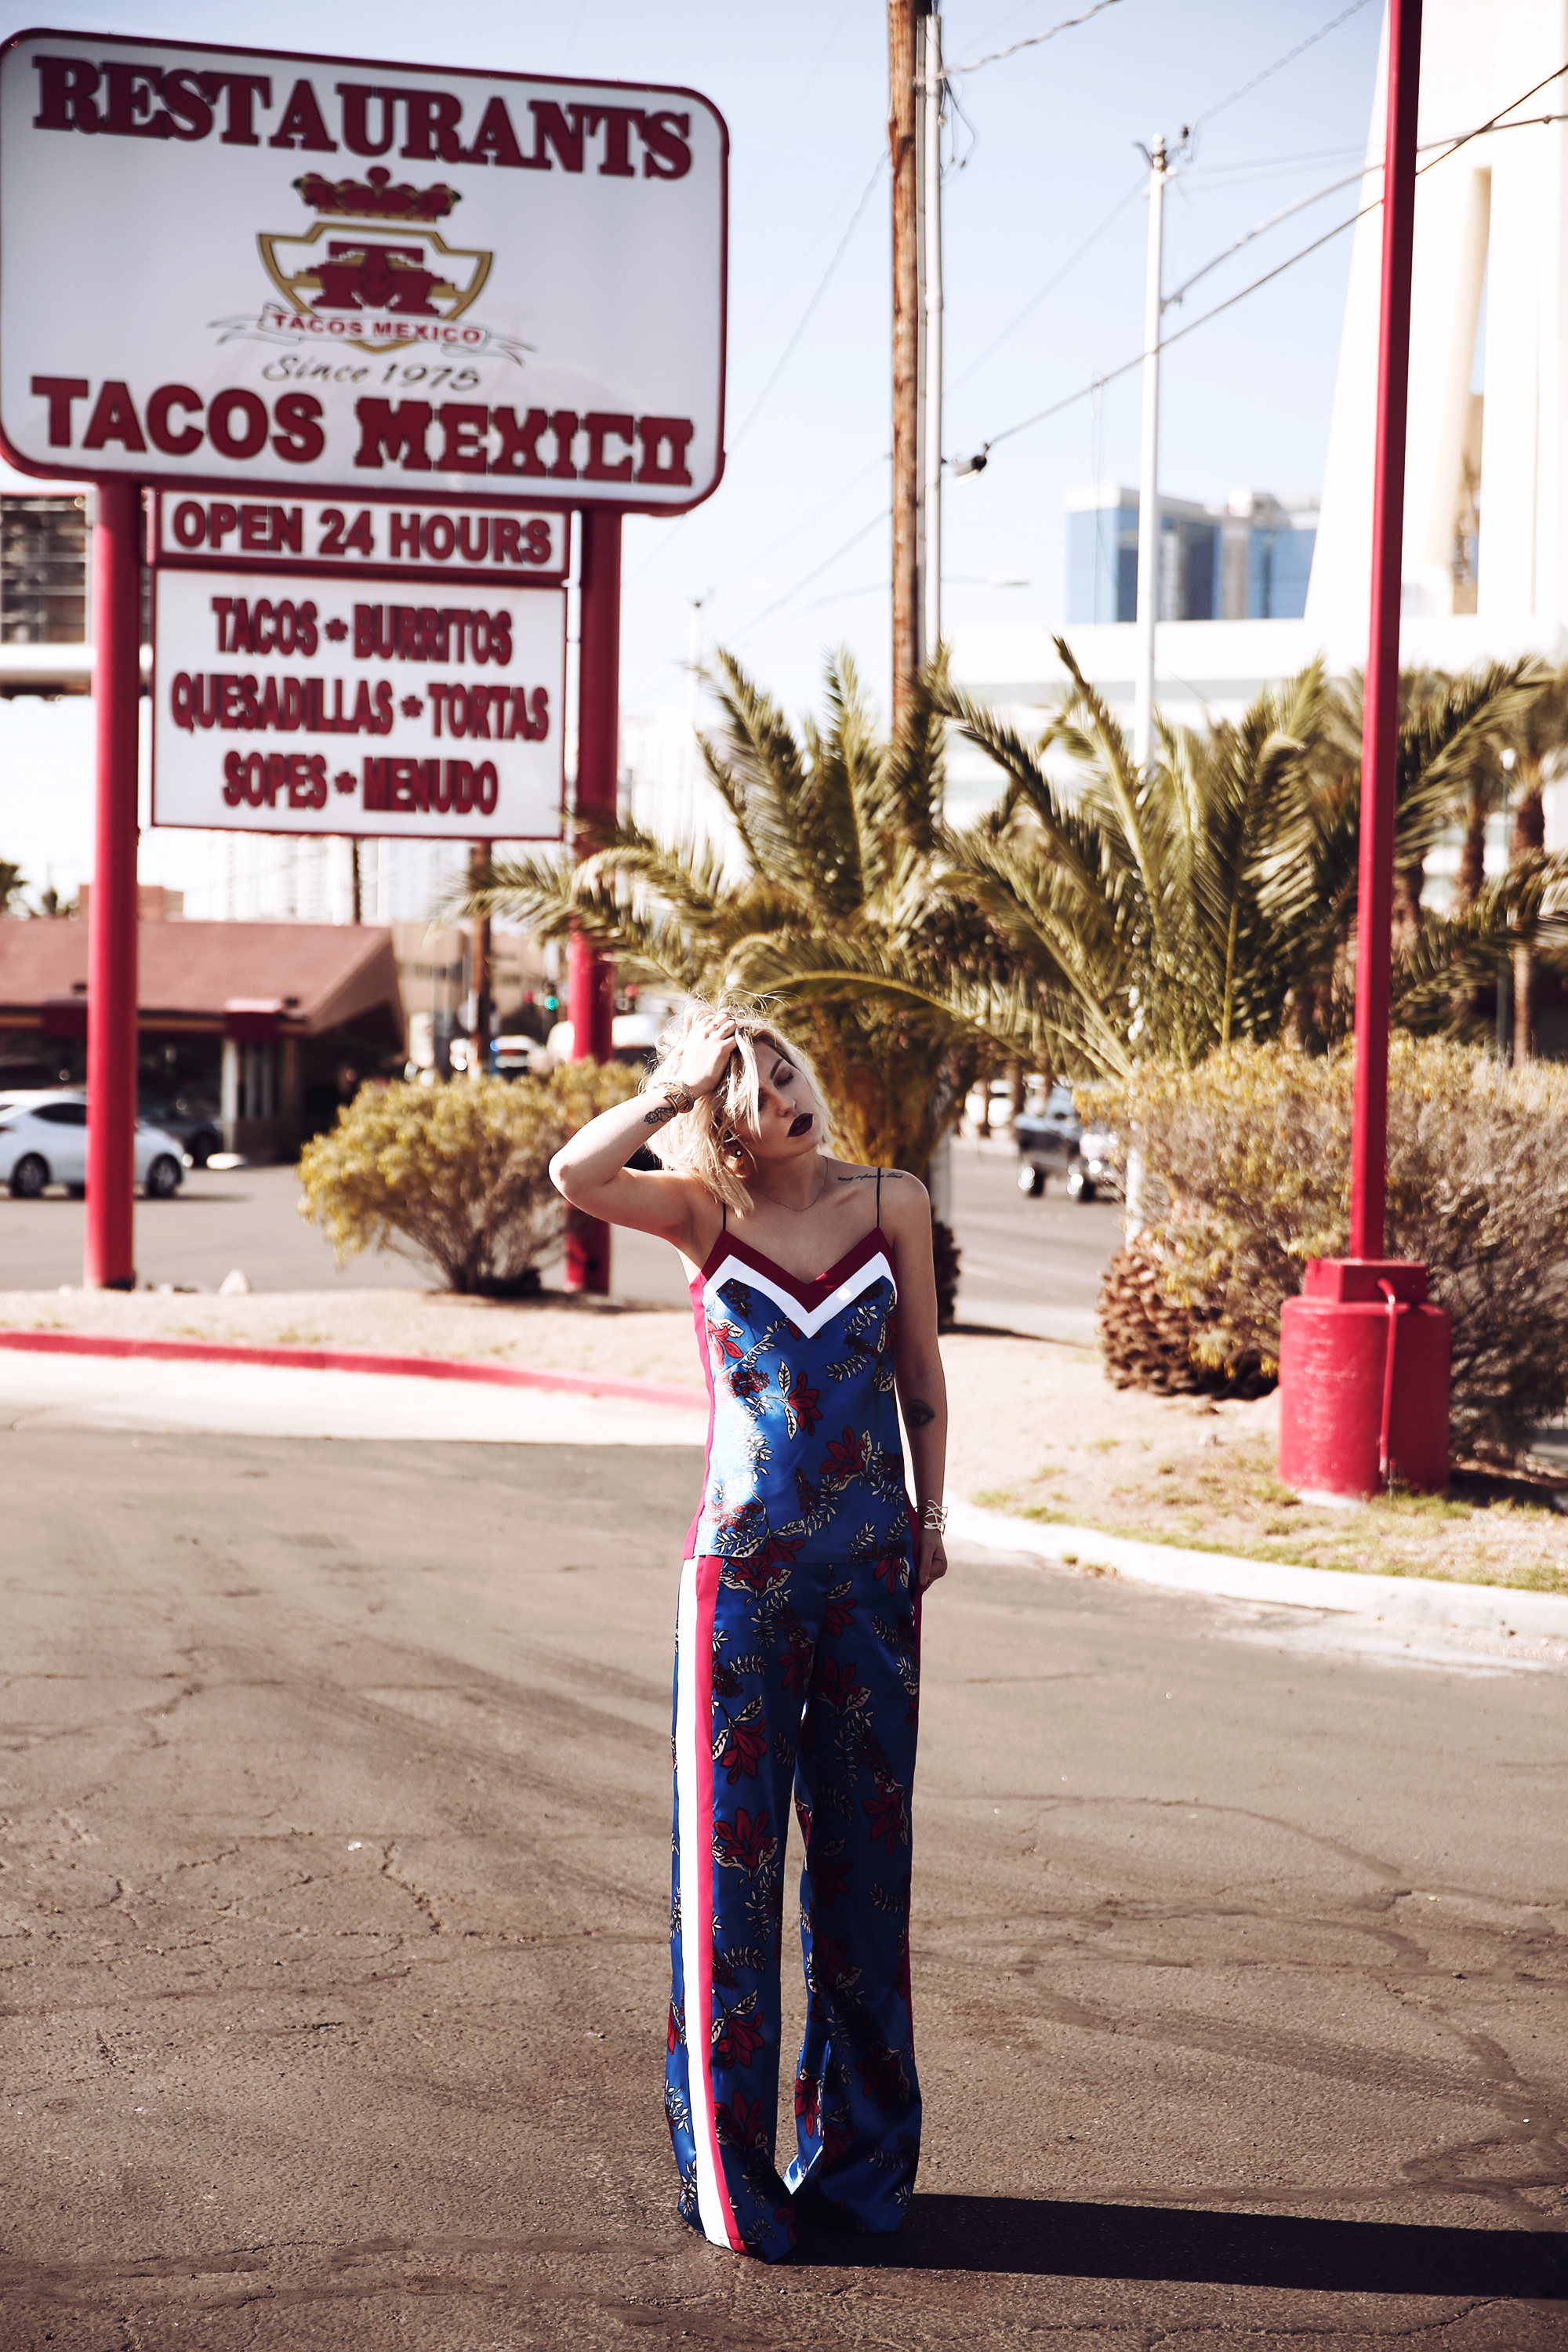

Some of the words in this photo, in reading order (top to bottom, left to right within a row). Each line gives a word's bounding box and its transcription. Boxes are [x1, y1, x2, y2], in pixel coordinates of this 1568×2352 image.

[32, 56, 691, 180] RESTAURANTS
[272, 313, 363, 336] TACOS
[372, 319, 481, 344] MEXICO
[262, 355, 371, 384] Since
[381, 363, 481, 391] 1975
[31, 376, 325, 464] TACOS
[353, 397, 695, 487] MEXICO
[172, 500, 303, 554] OPEN
[318, 509, 374, 557] 24
[390, 513, 552, 564] HOURS
[212, 597, 319, 657] TACOS
[353, 603, 513, 666] BURRITOS
[170, 671, 394, 735] QUESADILLAS
[426, 682, 550, 742] TORTAS
[223, 750, 328, 811] SOPES
[362, 756, 499, 816] MENUDO
